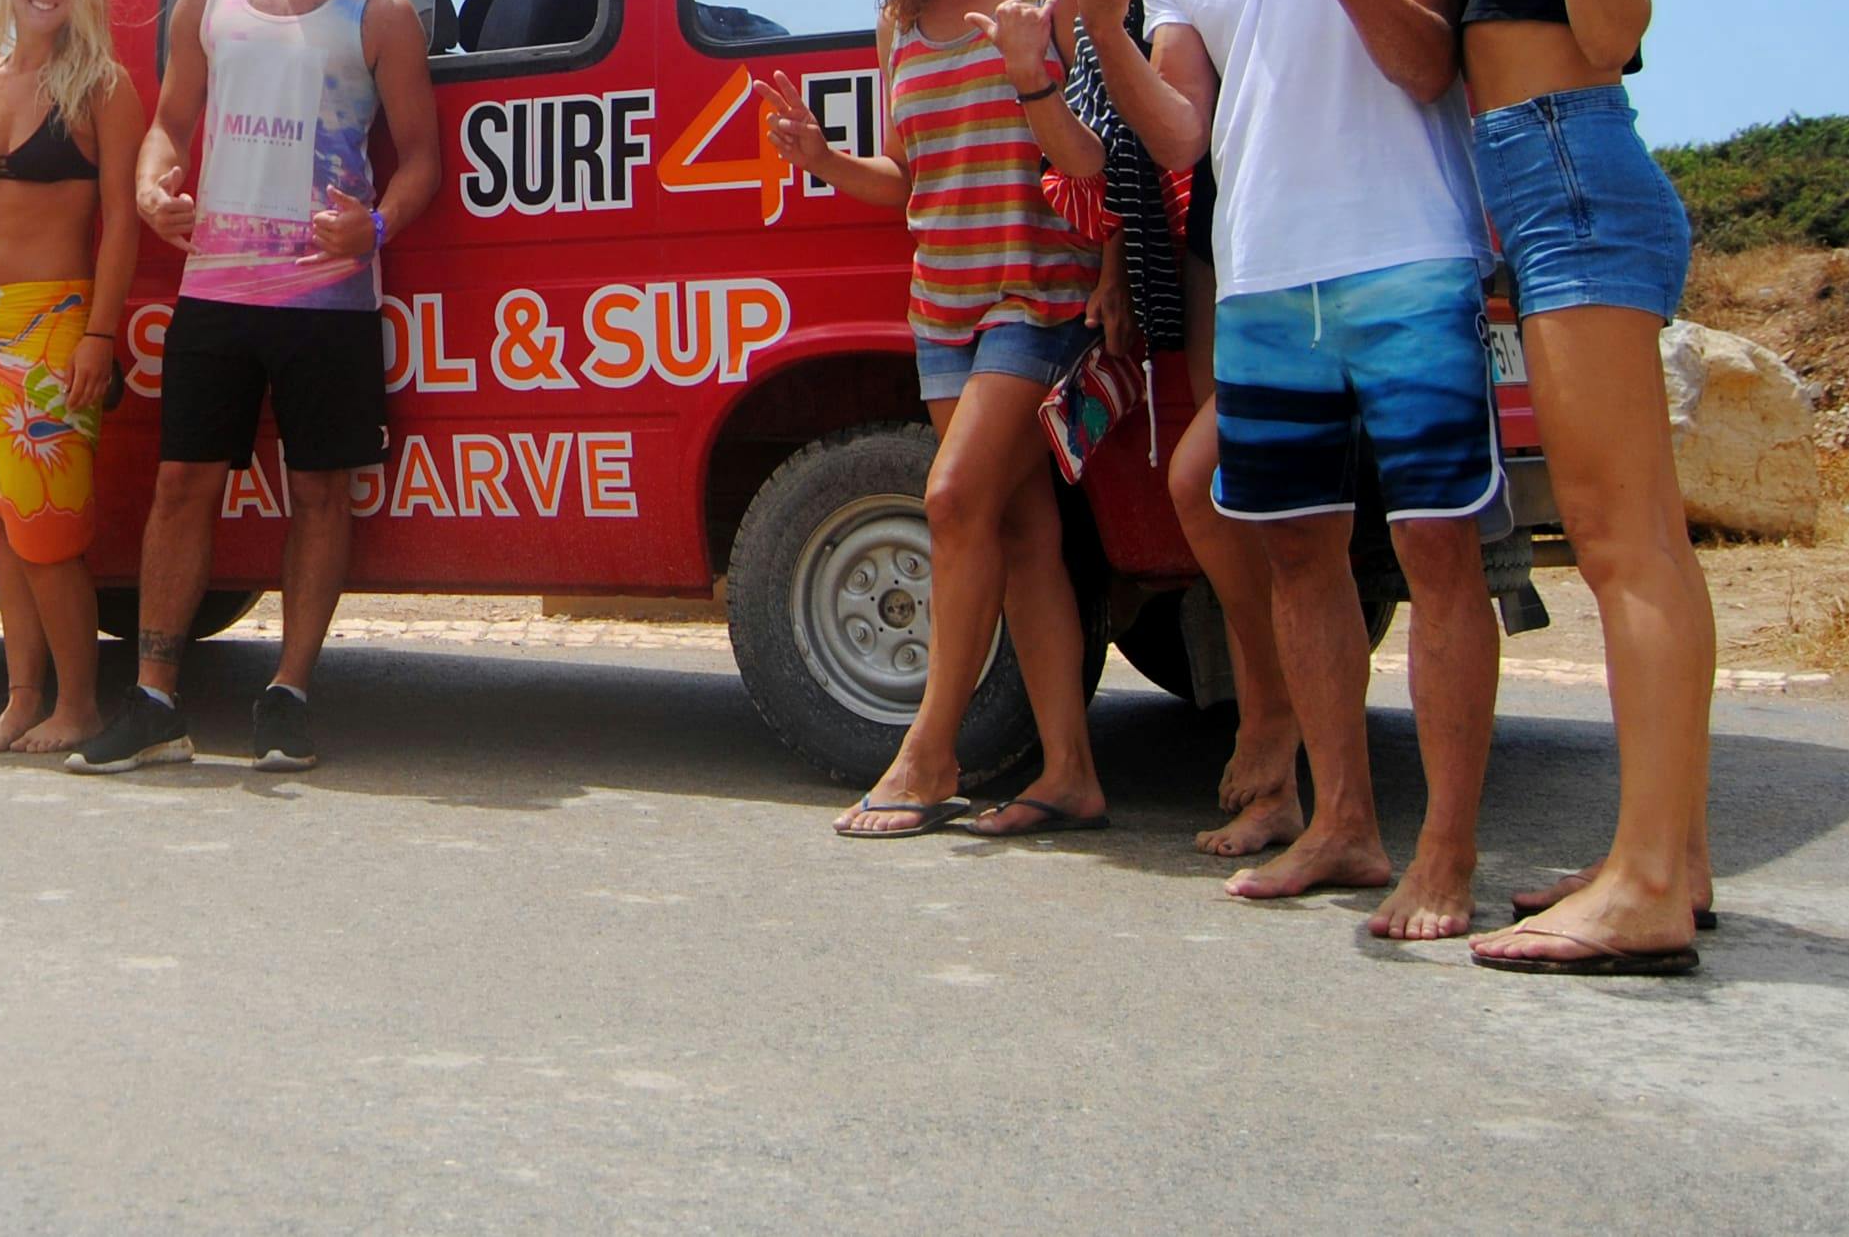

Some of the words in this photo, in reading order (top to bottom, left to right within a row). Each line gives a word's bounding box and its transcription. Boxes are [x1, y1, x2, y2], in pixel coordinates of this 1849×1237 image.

[224, 113, 304, 141] MIAMI
[460, 88, 656, 218] SURF
[489, 288, 580, 390] &
[580, 278, 790, 390] SUP
